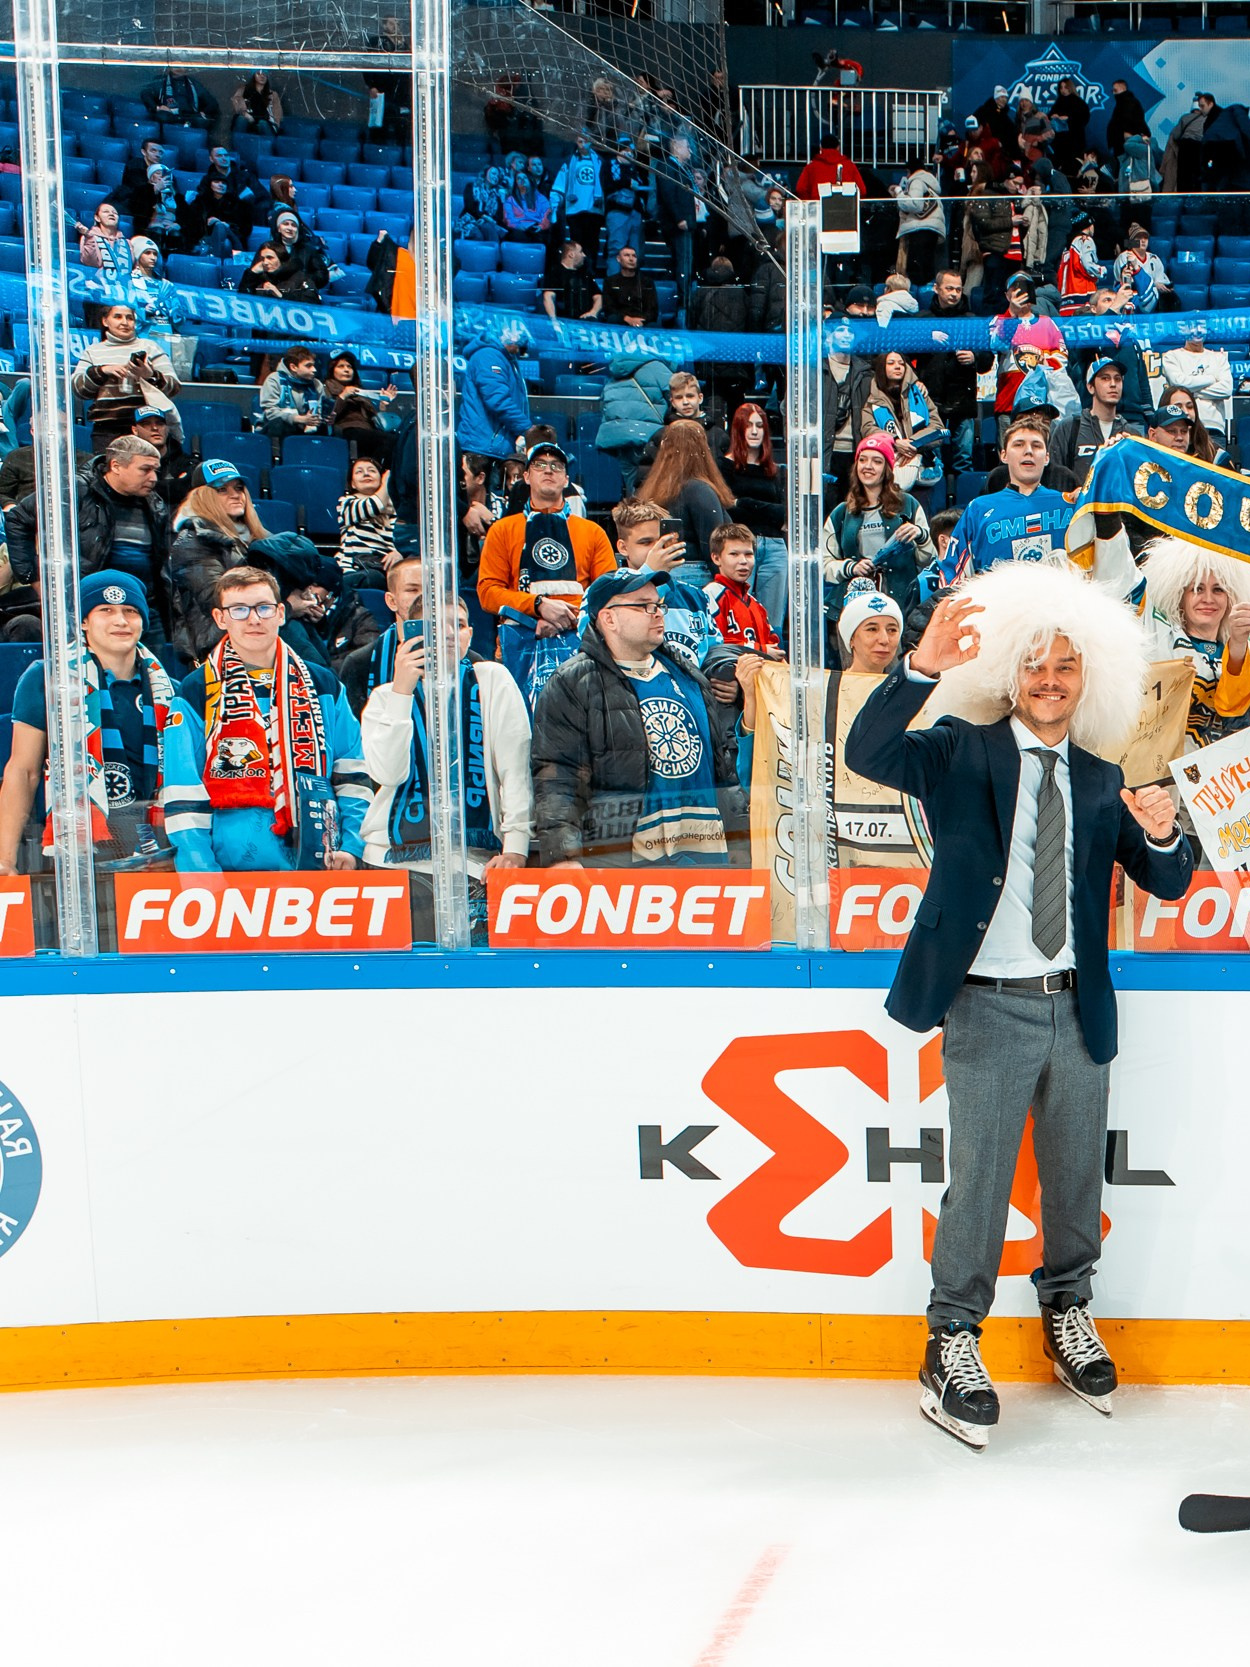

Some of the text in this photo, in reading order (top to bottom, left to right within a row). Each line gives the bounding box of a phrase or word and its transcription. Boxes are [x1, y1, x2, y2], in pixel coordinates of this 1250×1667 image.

[845, 821, 893, 838] 17.07.
[124, 886, 403, 940] FONBET
[495, 884, 766, 937] FONBET
